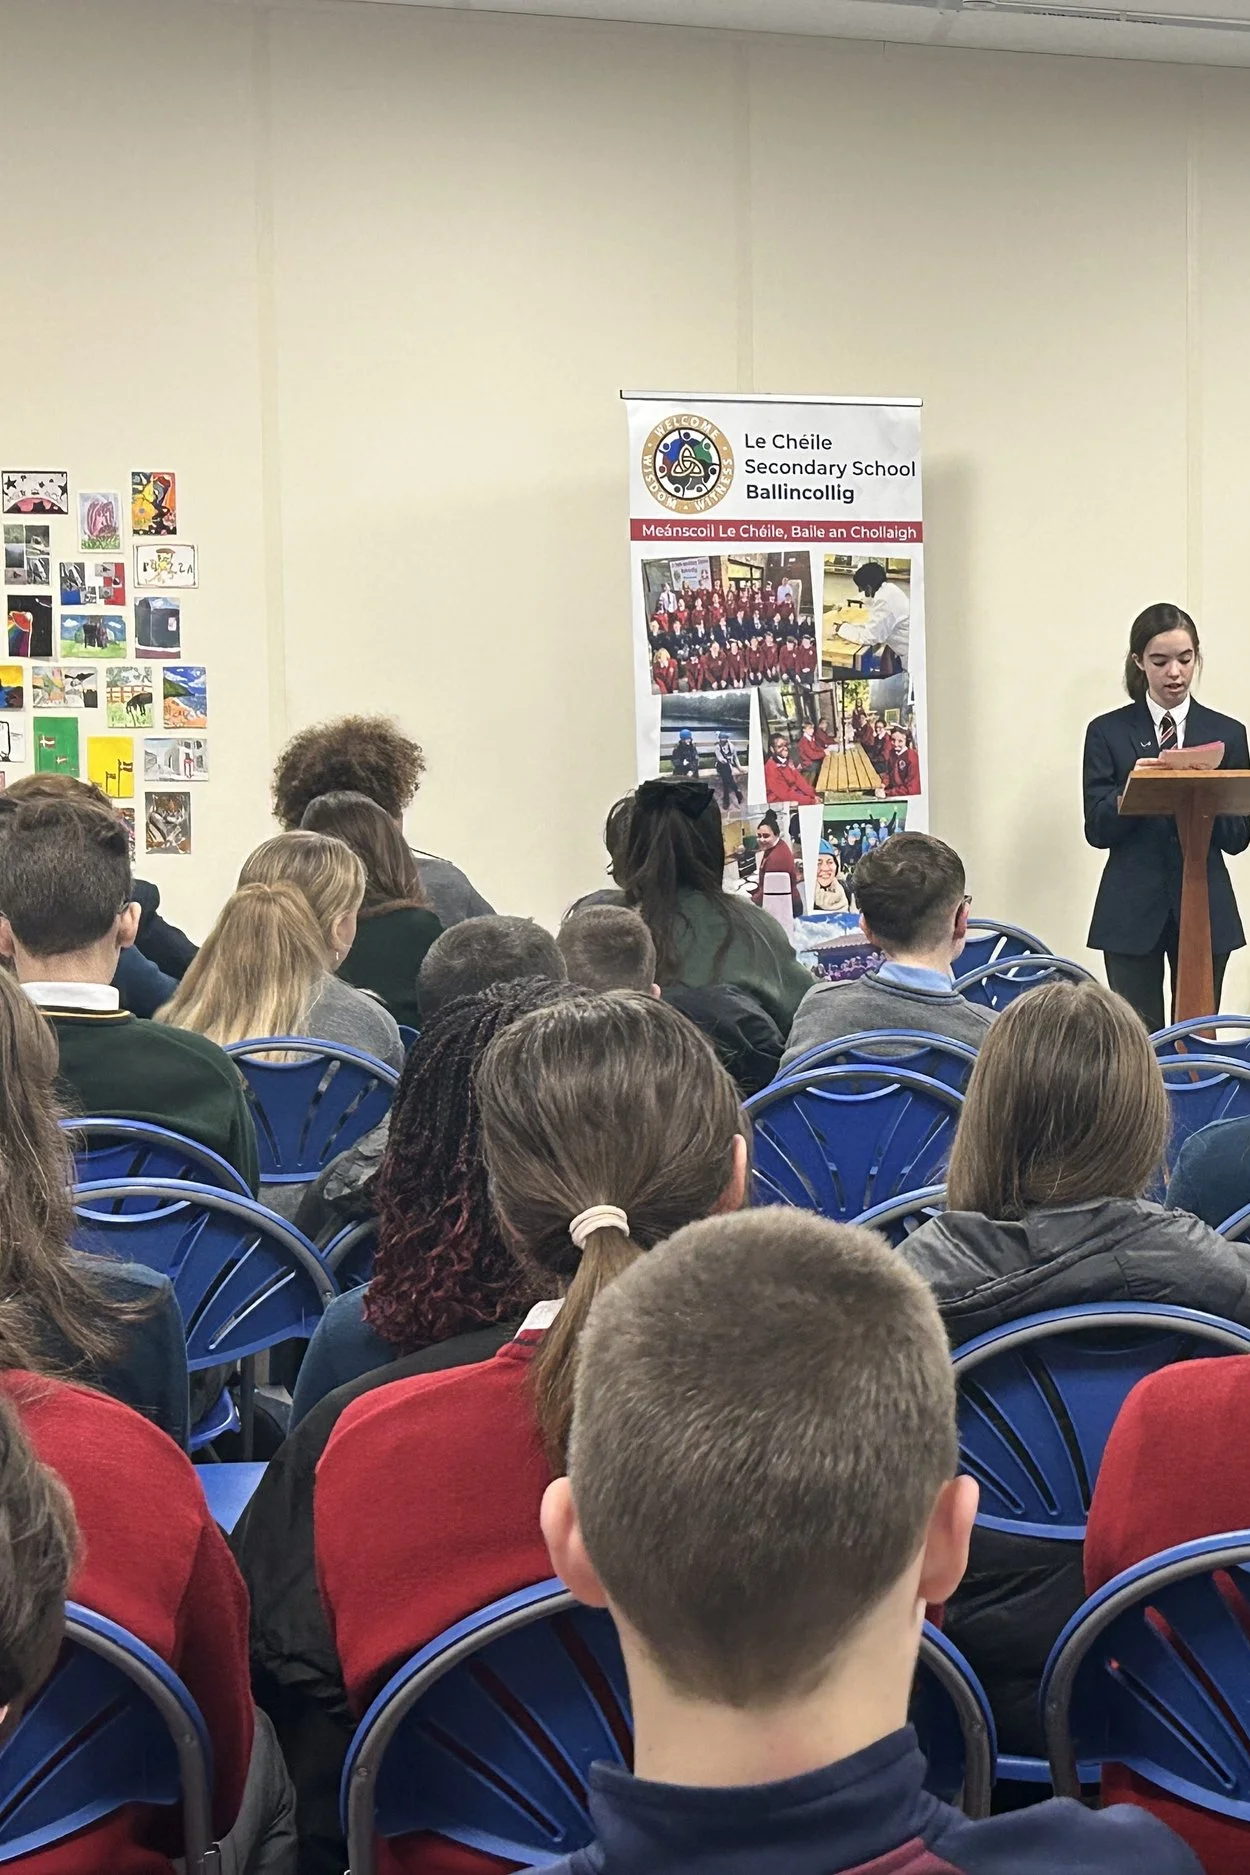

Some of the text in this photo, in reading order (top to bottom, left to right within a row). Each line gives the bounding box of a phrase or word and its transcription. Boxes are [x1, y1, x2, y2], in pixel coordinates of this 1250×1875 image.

[654, 416, 719, 439] WELCOME
[745, 433, 833, 450] Le Chéile
[745, 459, 916, 479] Secondary School
[644, 454, 677, 509] WISDOM
[694, 459, 732, 511] WITNESS
[747, 483, 854, 504] Ballincollig
[642, 524, 714, 538] Meánscoil
[719, 525, 735, 538] Le
[792, 526, 825, 538] Baile
[829, 528, 846, 538] an
[850, 526, 916, 540] Chollaigh
